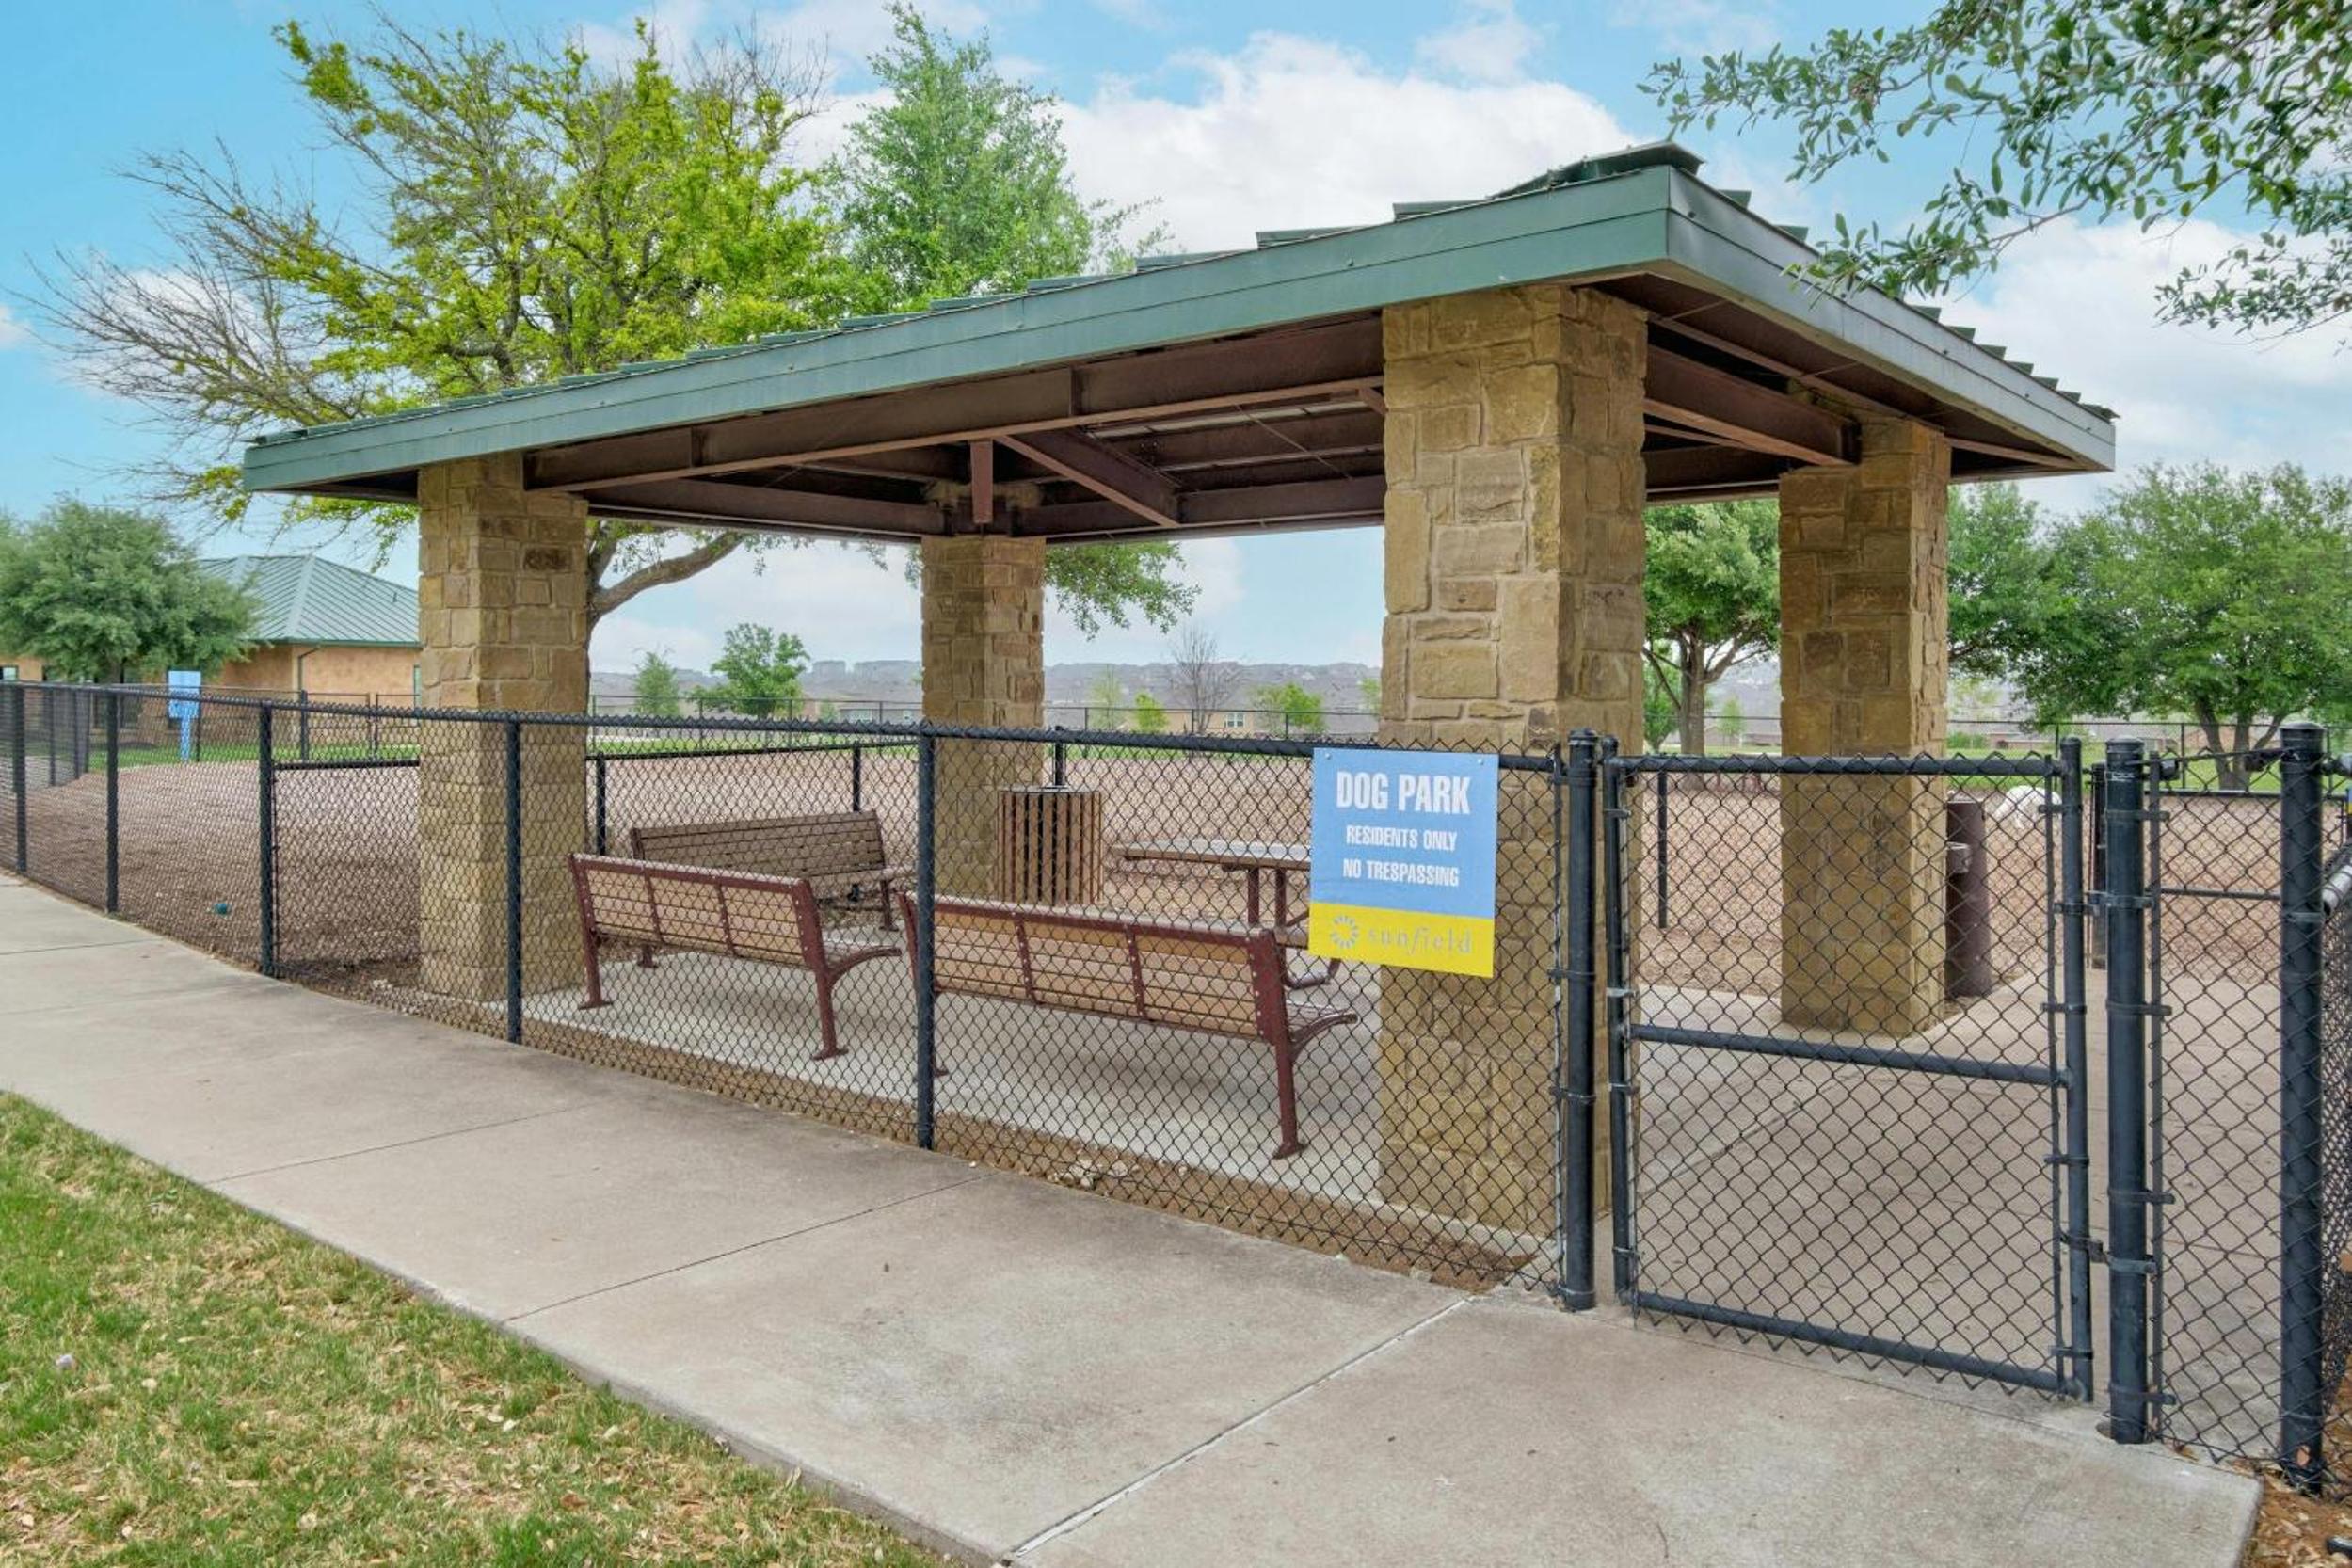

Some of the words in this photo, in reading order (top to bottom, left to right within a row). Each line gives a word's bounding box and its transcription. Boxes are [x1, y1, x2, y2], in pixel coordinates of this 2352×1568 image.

[1336, 771, 1388, 810] DOG
[1398, 775, 1470, 814] PARK
[1346, 825, 1417, 849] RESIDENTS
[1423, 830, 1457, 851] ONLY
[1343, 858, 1361, 878] NO
[1367, 860, 1459, 887] TRESPASSING
